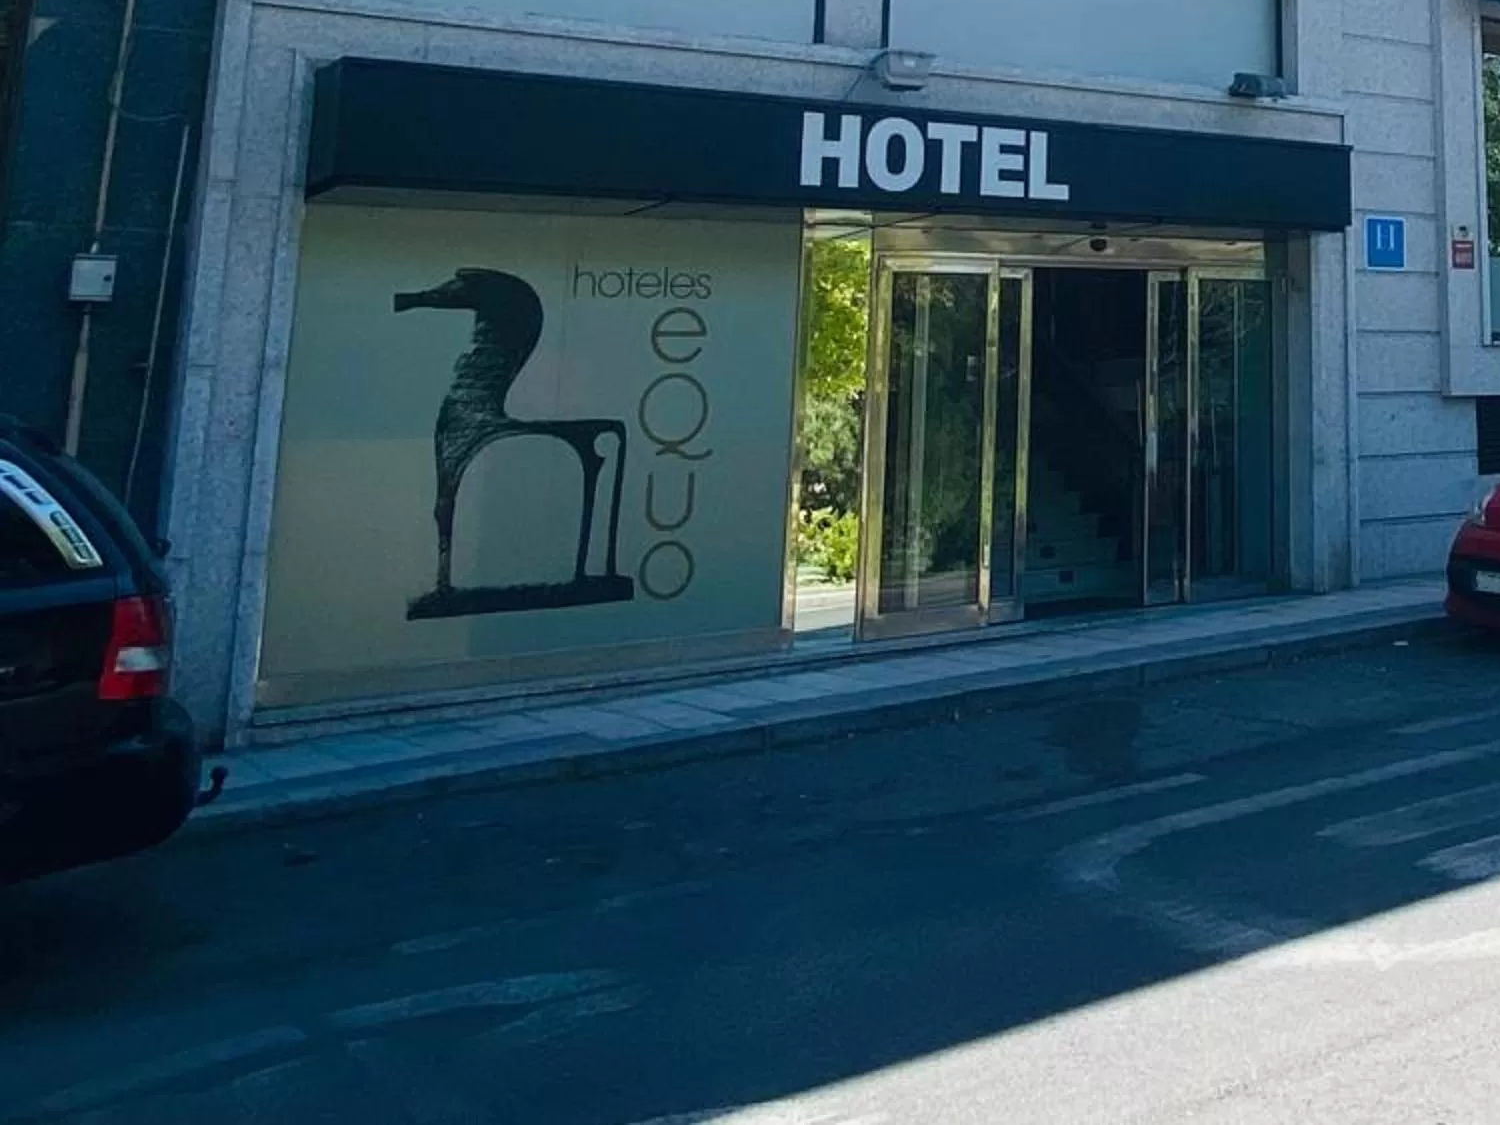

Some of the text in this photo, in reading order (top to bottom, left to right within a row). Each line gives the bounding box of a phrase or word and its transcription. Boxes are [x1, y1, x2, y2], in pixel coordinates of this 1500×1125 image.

[800, 111, 1069, 201] HOTEL
[1376, 223, 1395, 251] H
[572, 262, 712, 300] hoteles
